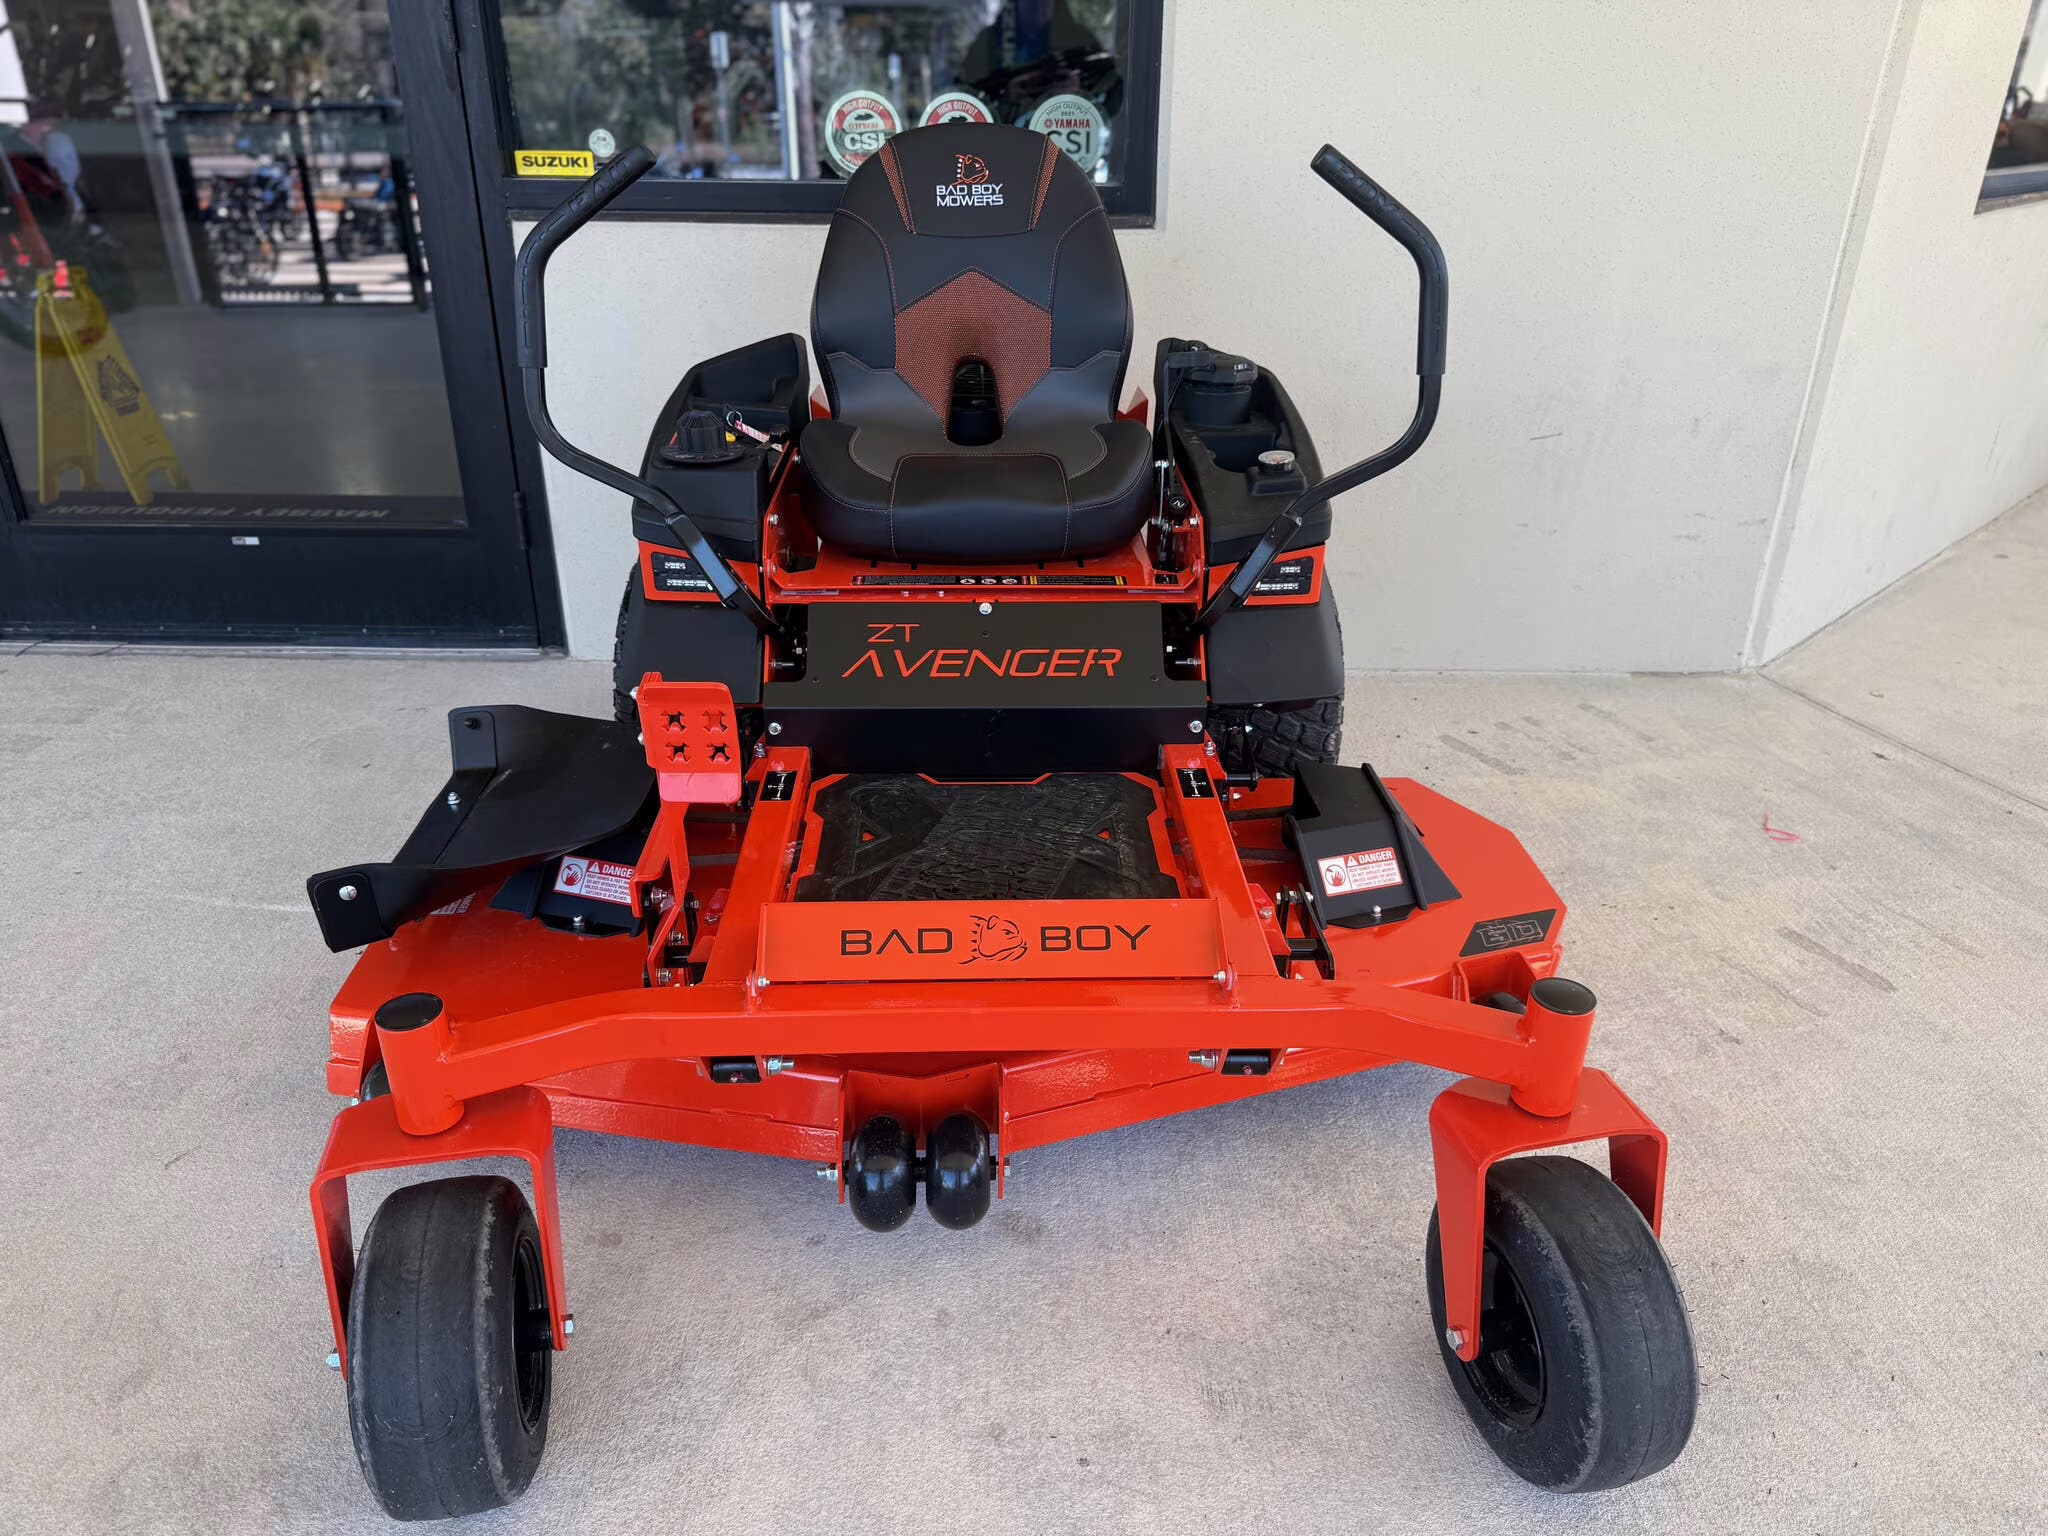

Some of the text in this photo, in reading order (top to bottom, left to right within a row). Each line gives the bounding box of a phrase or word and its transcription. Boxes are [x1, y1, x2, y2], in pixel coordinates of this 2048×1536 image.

[1054, 119, 1090, 128] YAMAHA
[844, 132, 885, 151] CSI
[522, 156, 588, 168] SUZUKI
[936, 183, 1003, 195] BAD BOY
[936, 195, 1004, 207] MOWERS
[867, 624, 920, 643] ZT
[841, 648, 1124, 678] AVENGER
[1359, 851, 1392, 863] DANGER
[602, 864, 634, 878] DANGE
[840, 924, 1152, 956] BAD BOY
